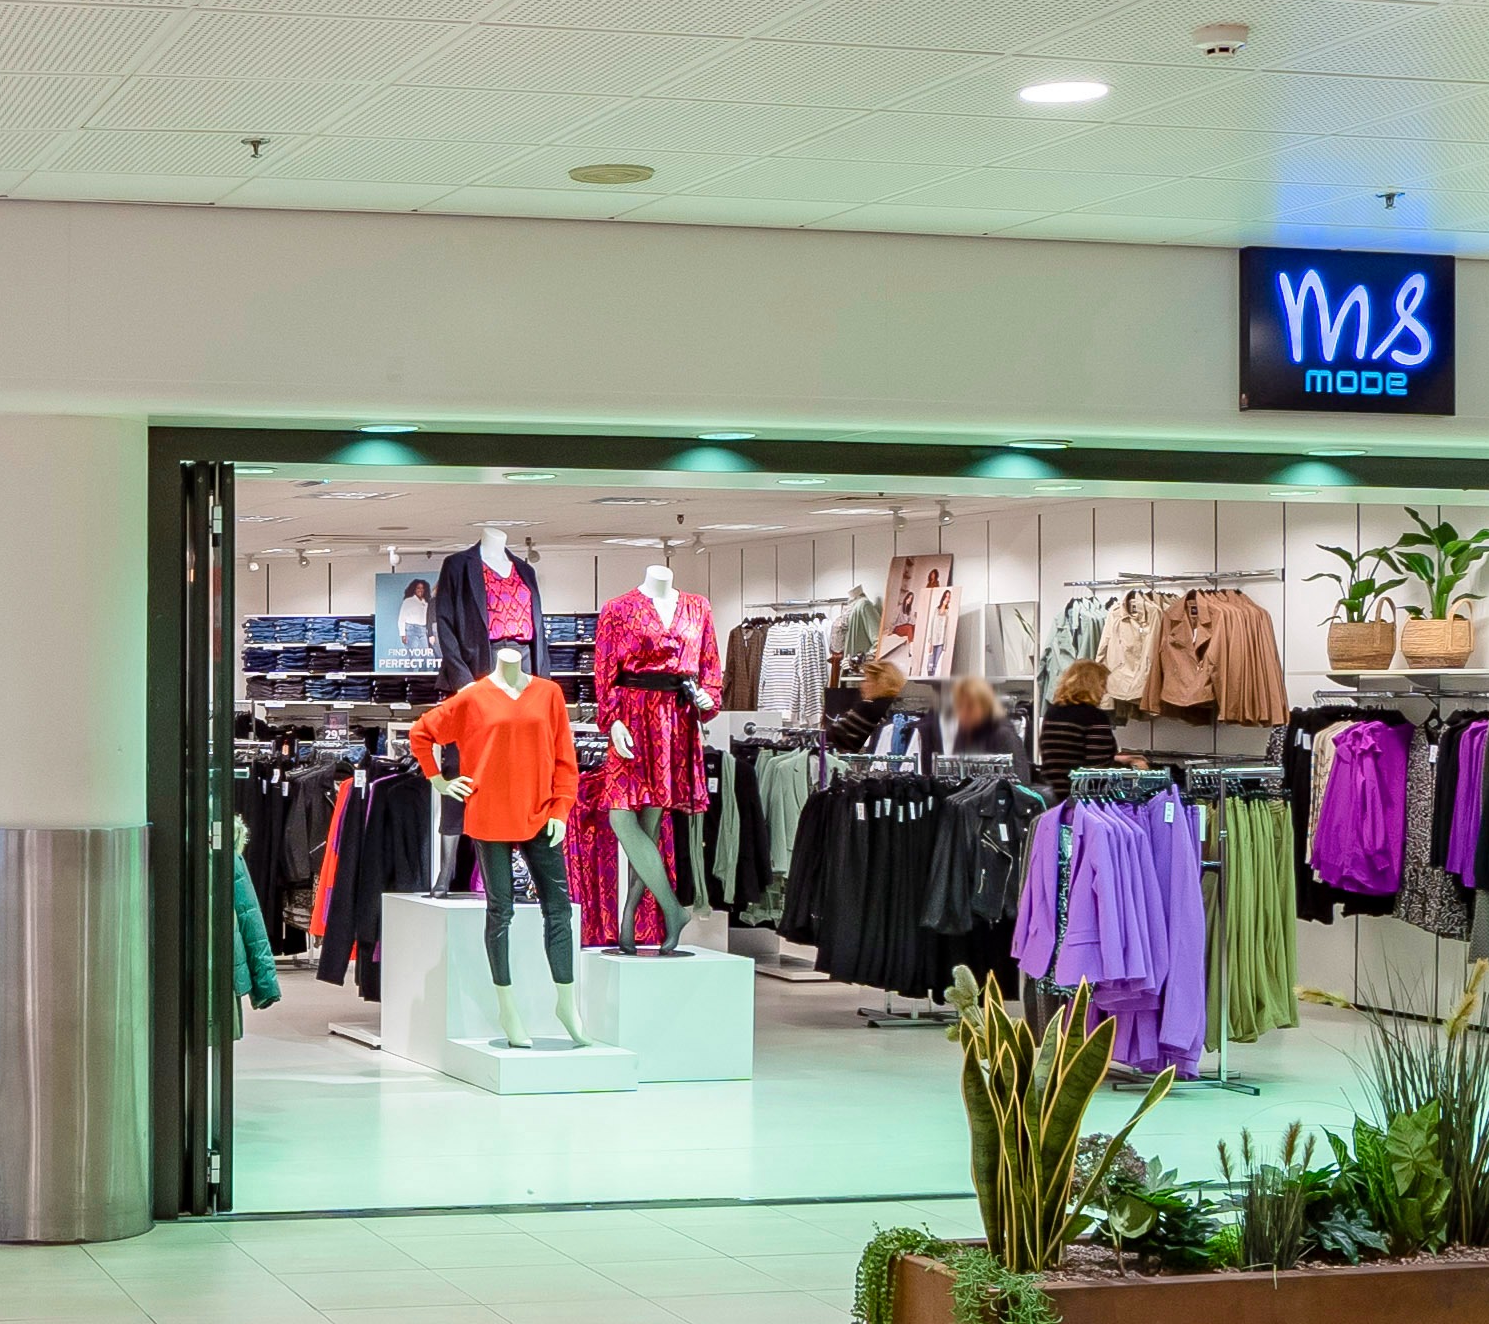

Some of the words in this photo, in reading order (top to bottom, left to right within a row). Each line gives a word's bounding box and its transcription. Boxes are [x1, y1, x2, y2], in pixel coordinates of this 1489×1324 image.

[388, 648, 408, 656] FIND
[409, 648, 434, 656] YOUR
[379, 659, 424, 669] PERFECT
[426, 658, 443, 669] FIT
